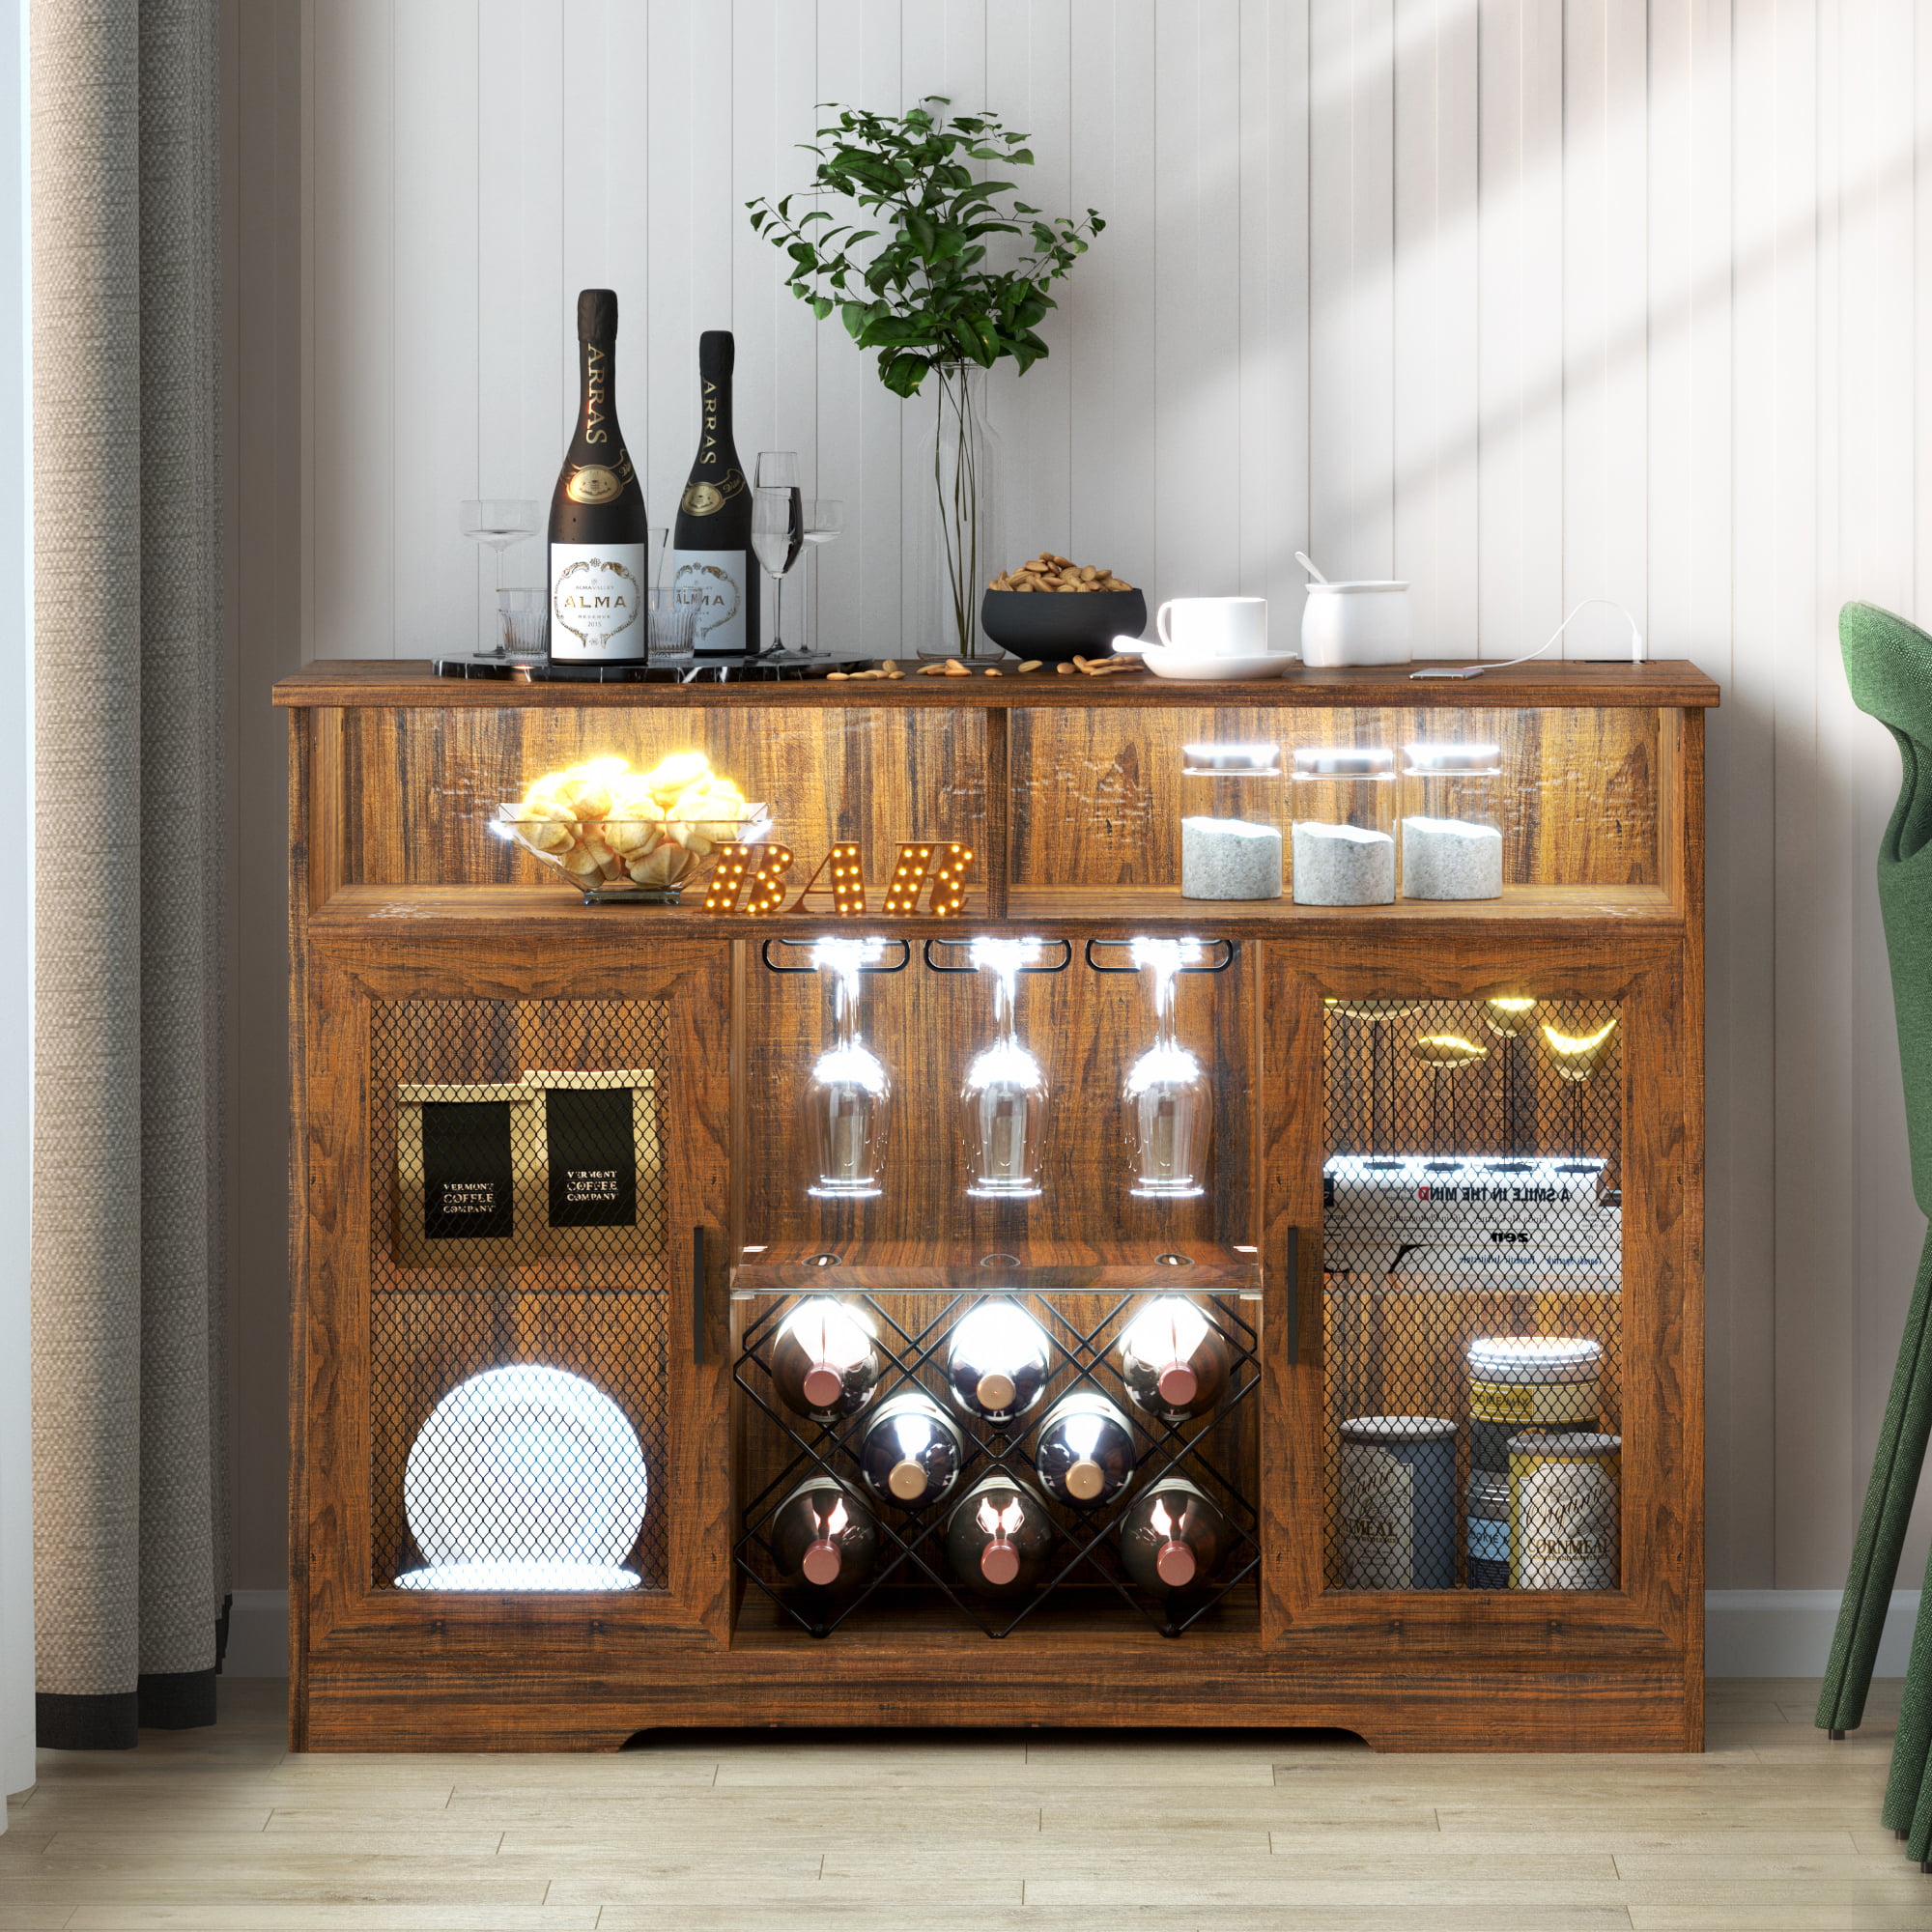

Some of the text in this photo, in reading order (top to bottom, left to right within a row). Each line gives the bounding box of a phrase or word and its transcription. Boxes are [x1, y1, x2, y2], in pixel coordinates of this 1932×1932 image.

[585, 343, 608, 445] ARRAS
[699, 379, 718, 466] ARRAS
[564, 595, 627, 609] ALMA
[693, 841, 976, 914] BAR
[566, 1180, 618, 1191] COFFEE
[1526, 1539, 1610, 1555] CORNMEAL
